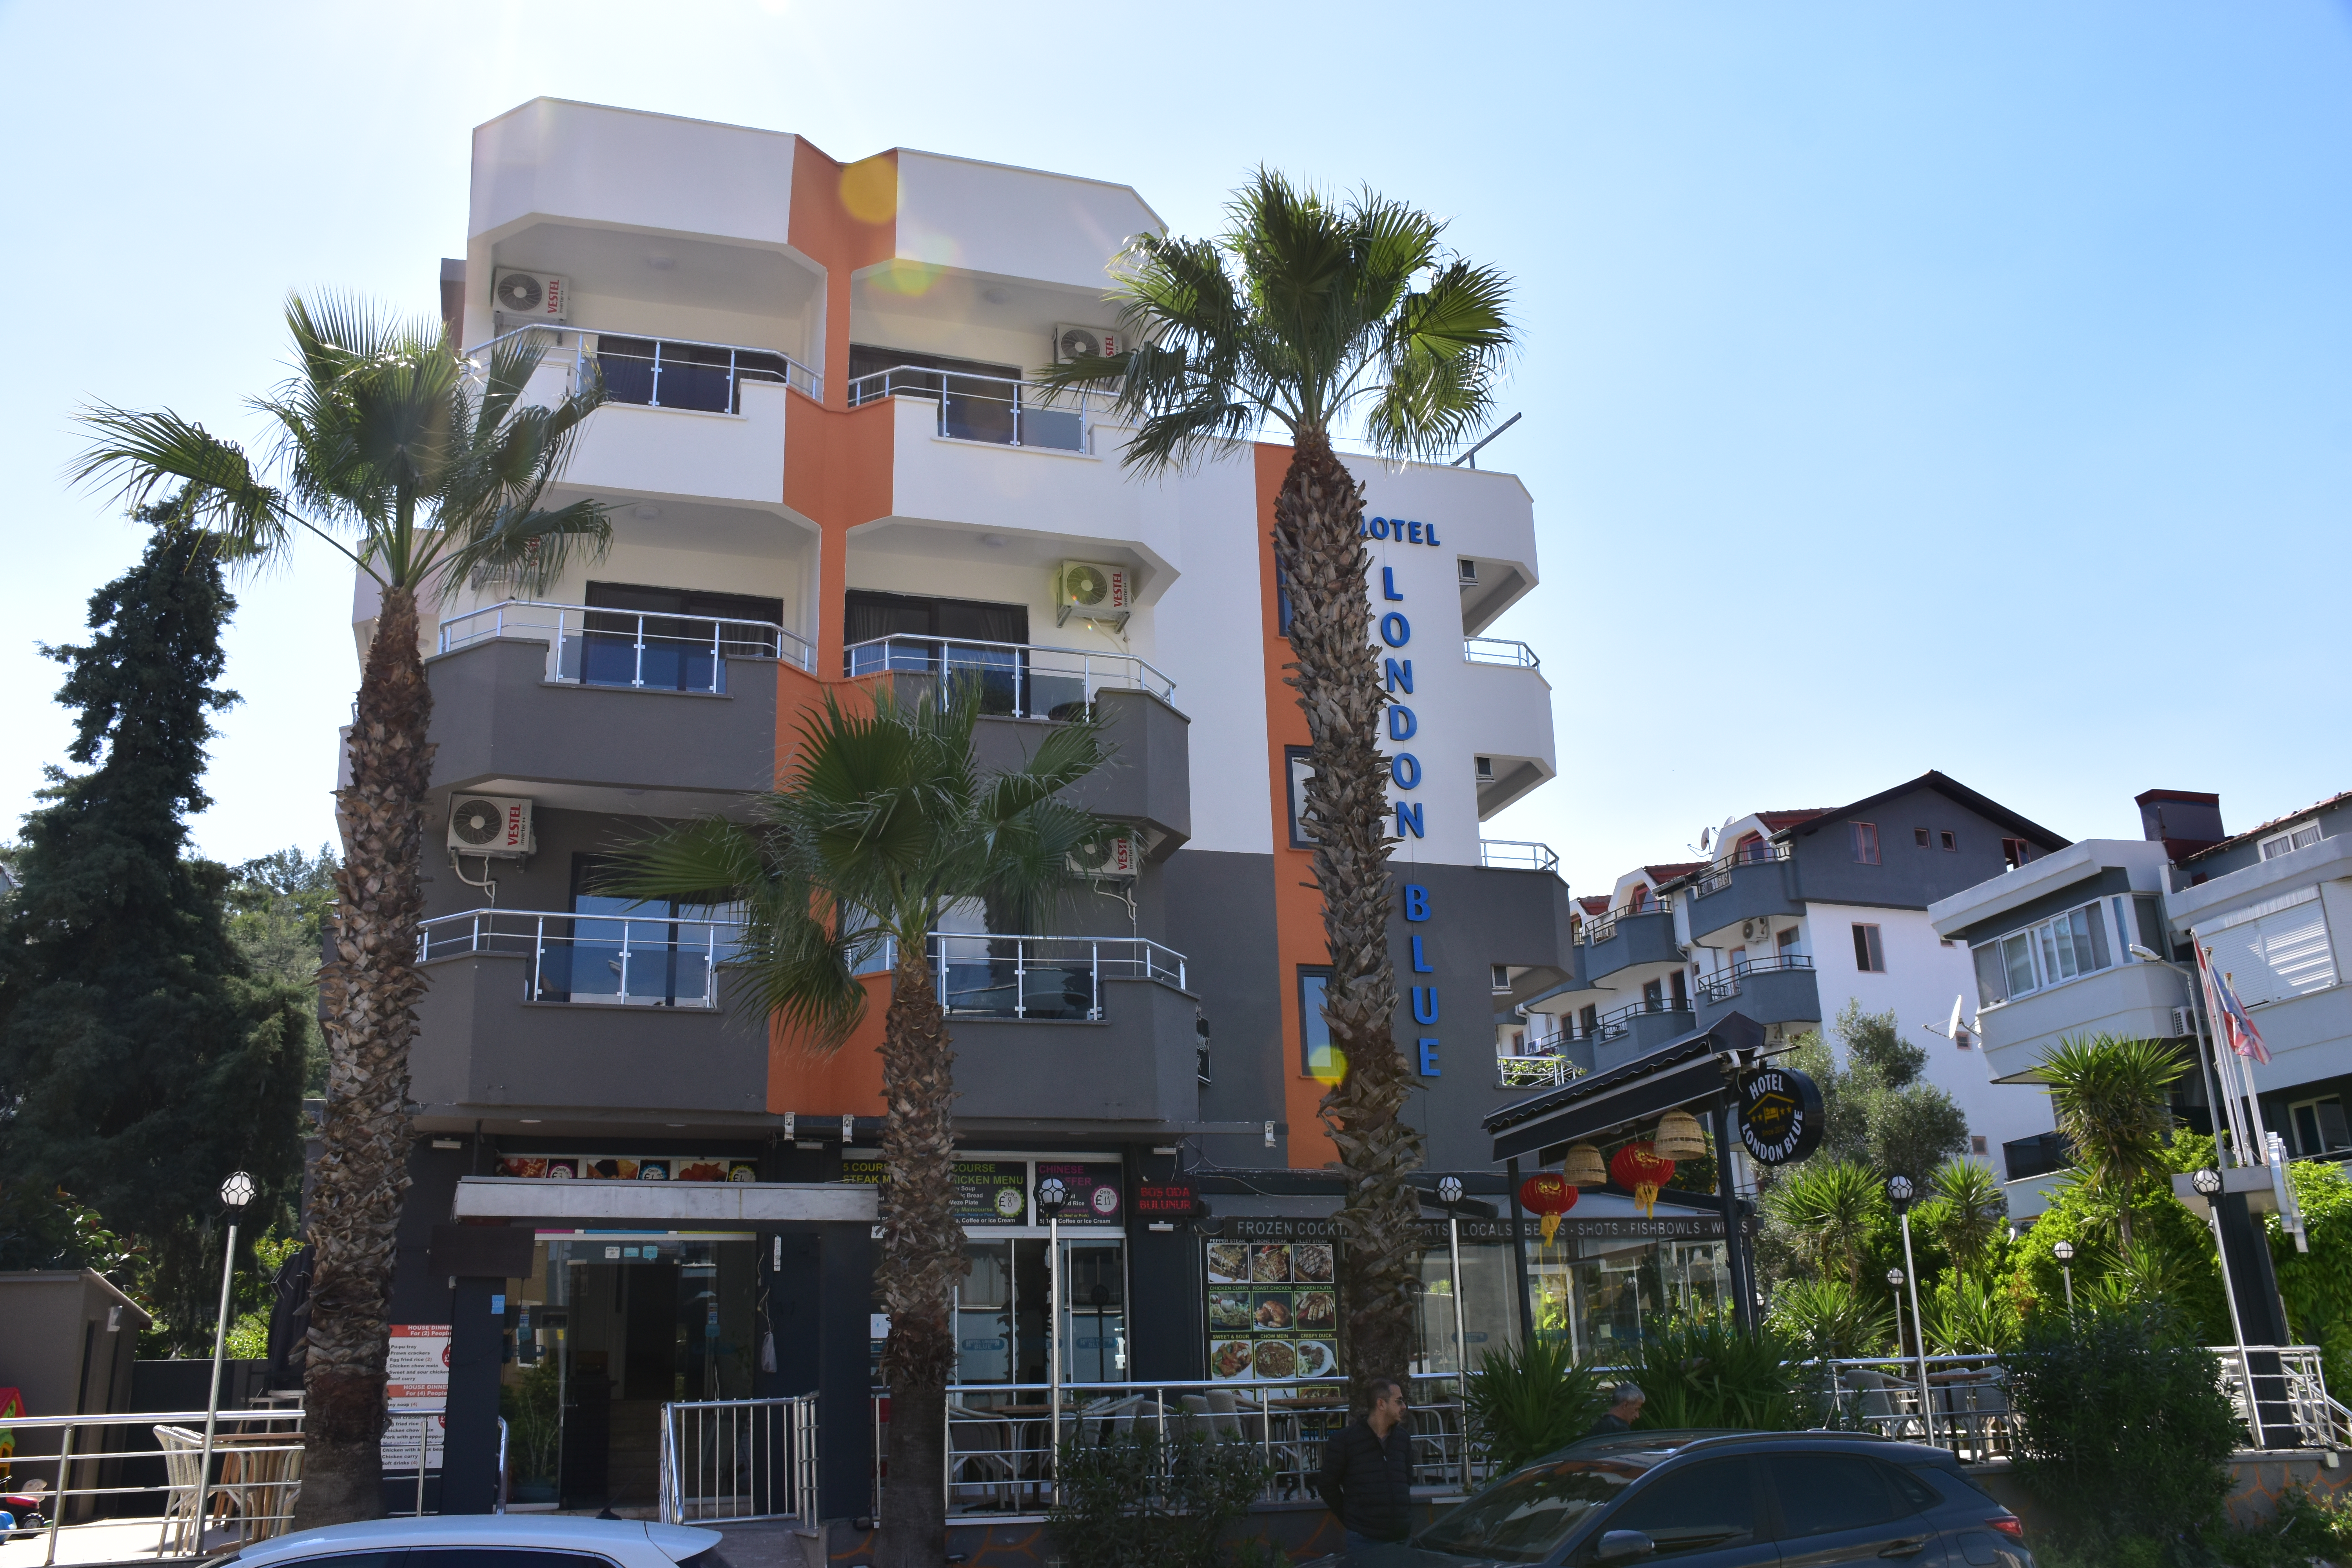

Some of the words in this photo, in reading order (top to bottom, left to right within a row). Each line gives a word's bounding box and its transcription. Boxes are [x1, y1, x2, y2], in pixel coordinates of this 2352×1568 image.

[547, 279, 559, 313] VESTEL
[1105, 336, 1114, 356] STEL
[1360, 515, 1441, 546] OTEL
[1113, 572, 1122, 607] VESTEL
[1381, 566, 1425, 839] LONDON
[507, 804, 521, 846] VESTEL
[1405, 884, 1441, 1076] BLUE
[1749, 1074, 1784, 1100] HOTEL
[1742, 1123, 1784, 1161] LONDON
[1784, 1109, 1803, 1154] BLUE
[843, 1163, 849, 1172] 5
[952, 1164, 996, 1172] COURSE
[1039, 1165, 1084, 1174] CHINESE
[843, 1175, 879, 1184] STEAK
[955, 1176, 990, 1184] ICKEN
[993, 1176, 1024, 1184] MENU
[1065, 1177, 1092, 1185] FFER
[1141, 1187, 1163, 1199] BOŞ
[1166, 1187, 1190, 1196] ODA
[1140, 1200, 1191, 1209] BULUNUR
[1238, 1221, 1292, 1235] FROZEN
[1298, 1222, 1347, 1235] COCKT
[1462, 1223, 1512, 1236] LOCALS
[1578, 1223, 1619, 1235] SHOTS
[1630, 1221, 1700, 1234] FISHBOWLS
